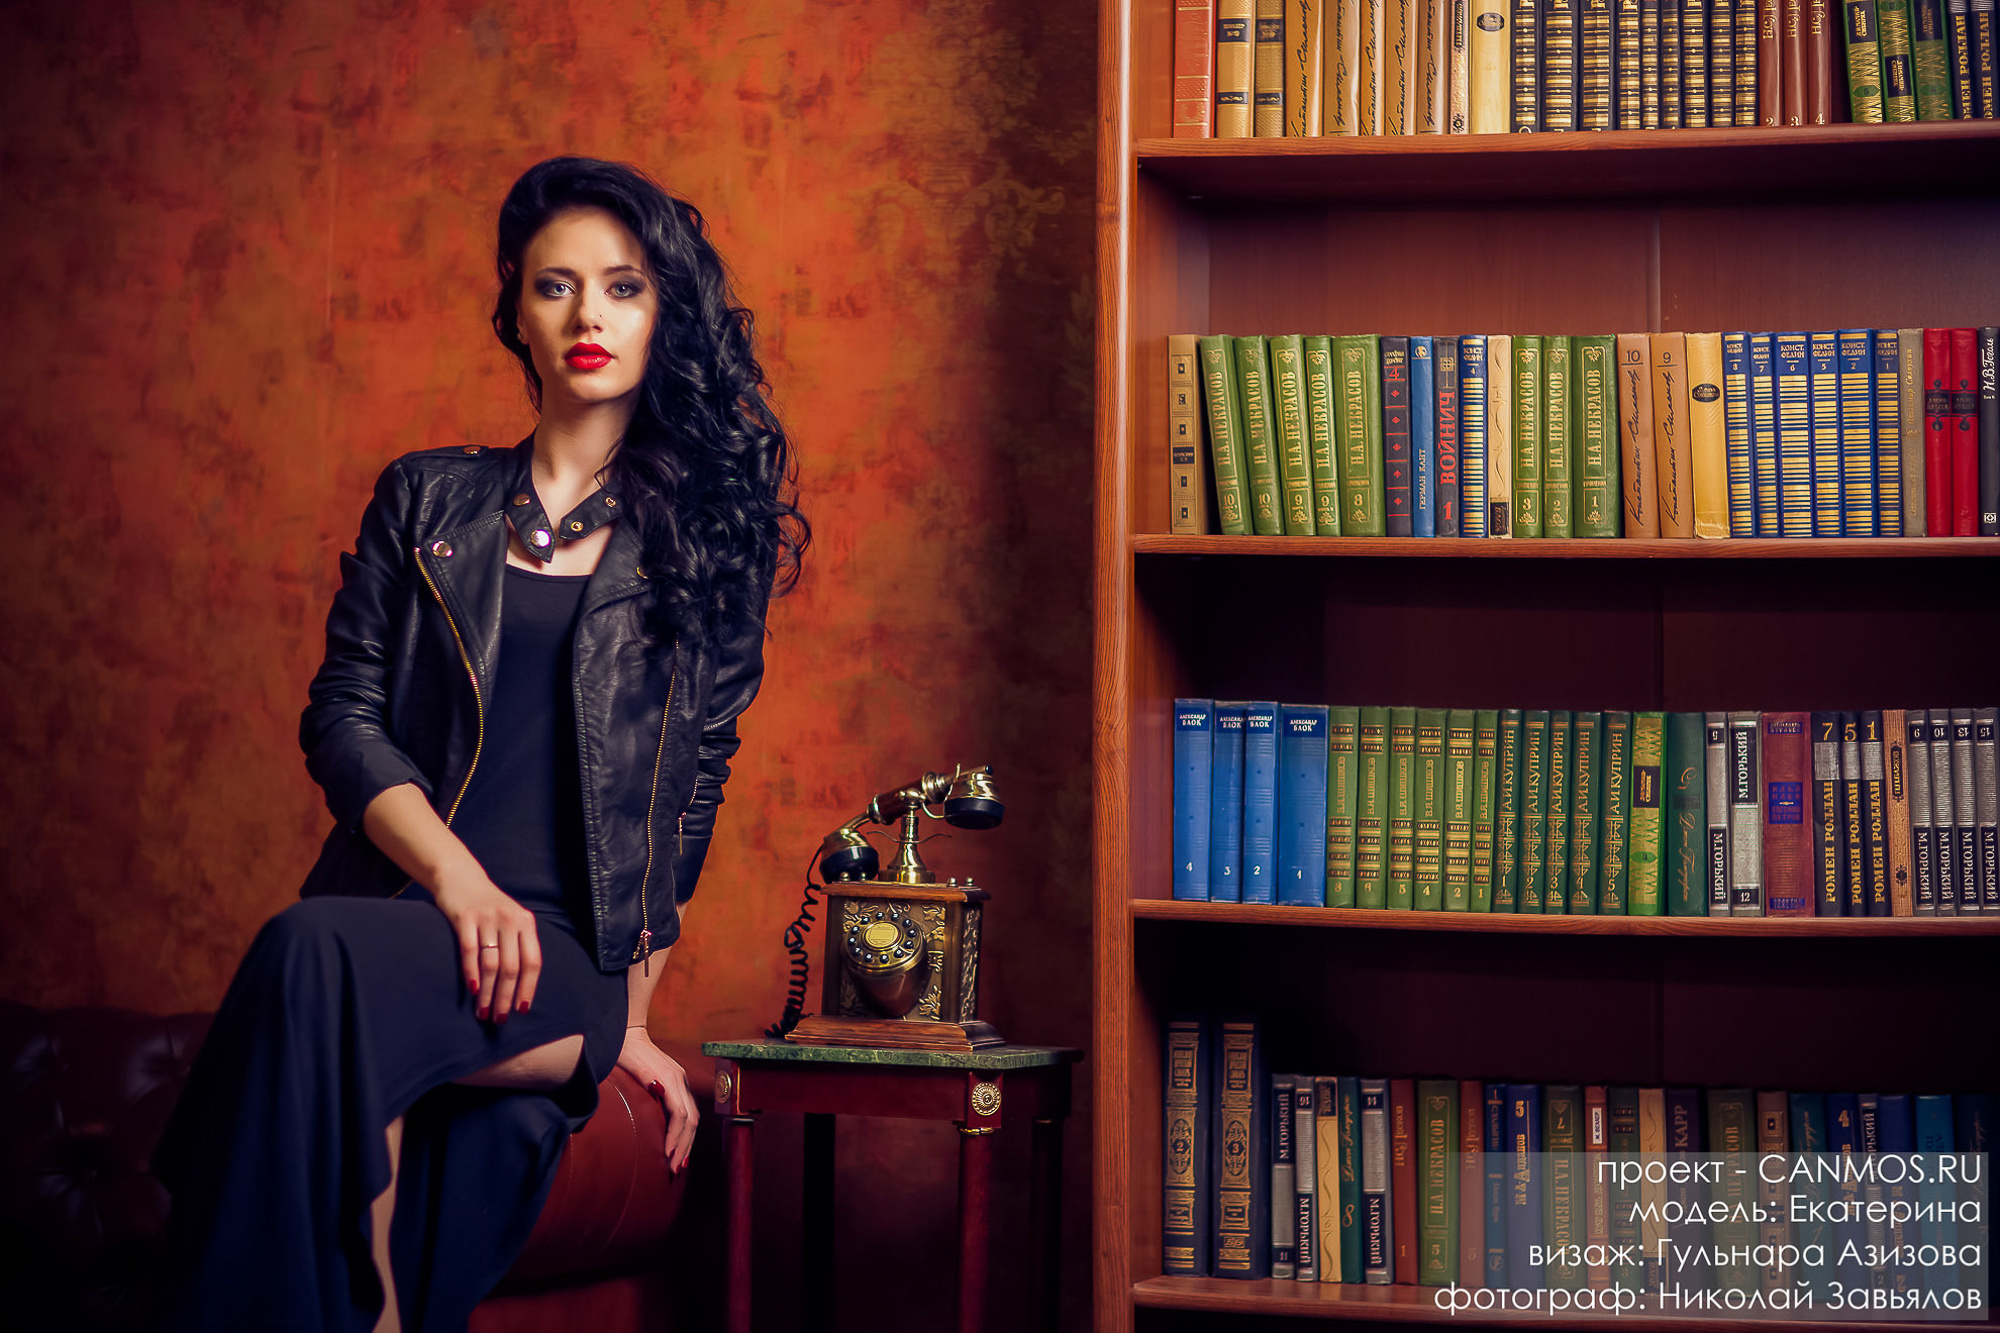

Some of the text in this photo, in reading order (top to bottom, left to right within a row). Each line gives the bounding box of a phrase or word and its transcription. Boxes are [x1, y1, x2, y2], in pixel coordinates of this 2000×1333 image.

[1955, 14, 1970, 75] РОЛЛАН
[1979, 12, 1992, 72] РОЛЛАН
[1814, 113, 1825, 125] 4
[1625, 349, 1641, 363] 10
[1662, 351, 1672, 364] 9
[1780, 350, 1805, 359] ФЕДИН
[1388, 367, 1400, 380] 4
[1209, 371, 1230, 440] НЕКРАСОВ
[1245, 371, 1266, 439] НЕКРАСОВ
[1281, 371, 1301, 440] НЕКРАСОВ
[1311, 373, 1329, 442] НЕКРАСОВ
[1347, 370, 1364, 439] НЕКРАСОВ
[1519, 371, 1535, 441] НЕКРАСОВ
[1549, 371, 1564, 440] НЕКРАСОВ
[1586, 369, 1602, 439] НЕКРАСОВ
[1437, 390, 1456, 486] ВОЙНИЧ
[1224, 493, 1235, 506] 10
[1258, 492, 1271, 505] 10
[1294, 494, 1303, 506] 9
[1320, 495, 1330, 507] 9
[1353, 493, 1363, 506] 8
[1522, 498, 1532, 511] 3
[1591, 495, 1599, 507] 1
[1442, 501, 1453, 520] 1
[1552, 500, 1561, 511] 2
[1223, 721, 1242, 729] БЛОК
[1250, 720, 1270, 728] БЛОК
[1293, 724, 1313, 732] БЛОК
[1866, 721, 1876, 740] 1
[1822, 722, 1833, 741] 7
[1844, 722, 1857, 742] 5
[1913, 727, 1920, 738] 9
[1933, 727, 1945, 738] 10
[1957, 727, 1969, 737] 13
[1980, 727, 1990, 737] 15
[1823, 781, 1836, 903] РОМЕН РОЛЛАН
[1848, 782, 1862, 906] РОМЕН РОЛЛАН
[1869, 781, 1885, 903] РОМЕН РОЛЛАН
[1186, 861, 1193, 872] 4
[1224, 866, 1231, 876] 3
[1253, 865, 1261, 875] 2
[1296, 869, 1302, 880] 1
[1502, 875, 1506, 887] 1
[1364, 882, 1372, 892] 6
[1398, 883, 1406, 895] 5
[1526, 876, 1534, 889] 2
[1550, 876, 1559, 889] 3
[1576, 876, 1584, 890] 4
[1607, 878, 1616, 891] 5
[1422, 884, 1430, 896] 4
[1453, 887, 1461, 898] 2
[1478, 888, 1484, 898] 1
[1740, 891, 1751, 903] 12
[1674, 1104, 1689, 1148] КАРР
[1176, 1142, 1184, 1152] 2
[1232, 1143, 1240, 1153] 3
[1429, 1119, 1445, 1188] НЕКРАСОВ
